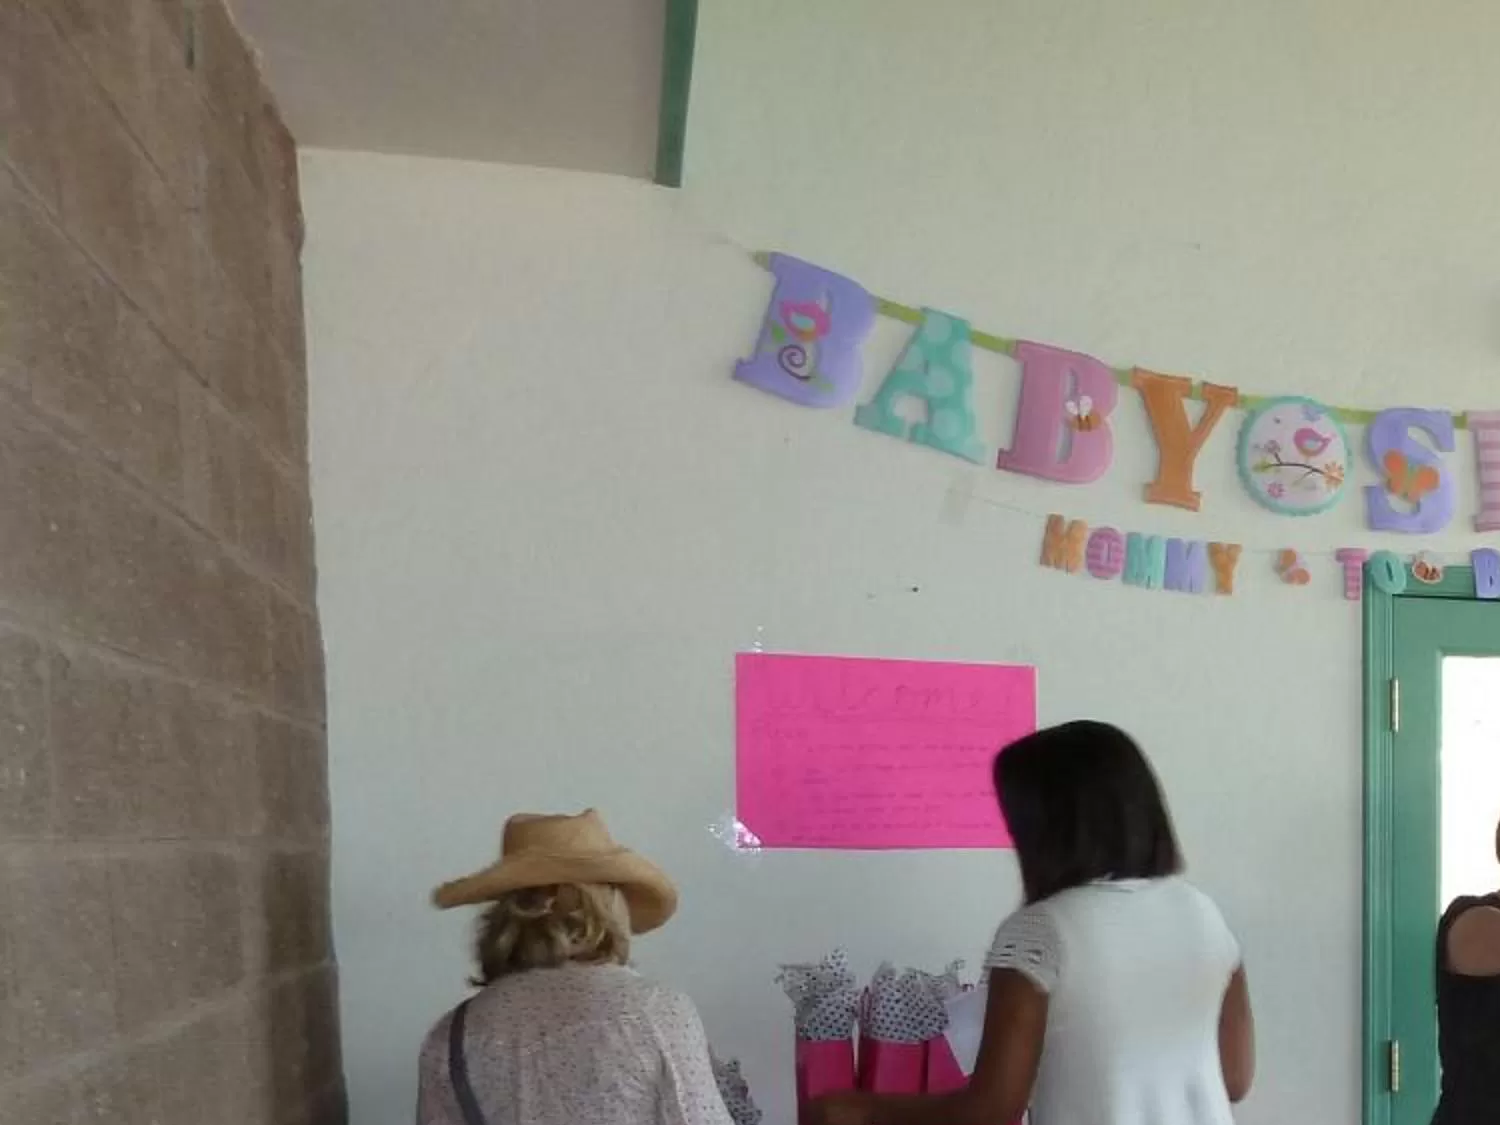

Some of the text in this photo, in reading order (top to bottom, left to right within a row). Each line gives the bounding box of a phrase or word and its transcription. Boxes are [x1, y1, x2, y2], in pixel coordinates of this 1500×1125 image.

[731, 251, 1238, 511] BABY
[1039, 513, 1243, 596] MOMMY
[1334, 547, 1408, 601] TO
